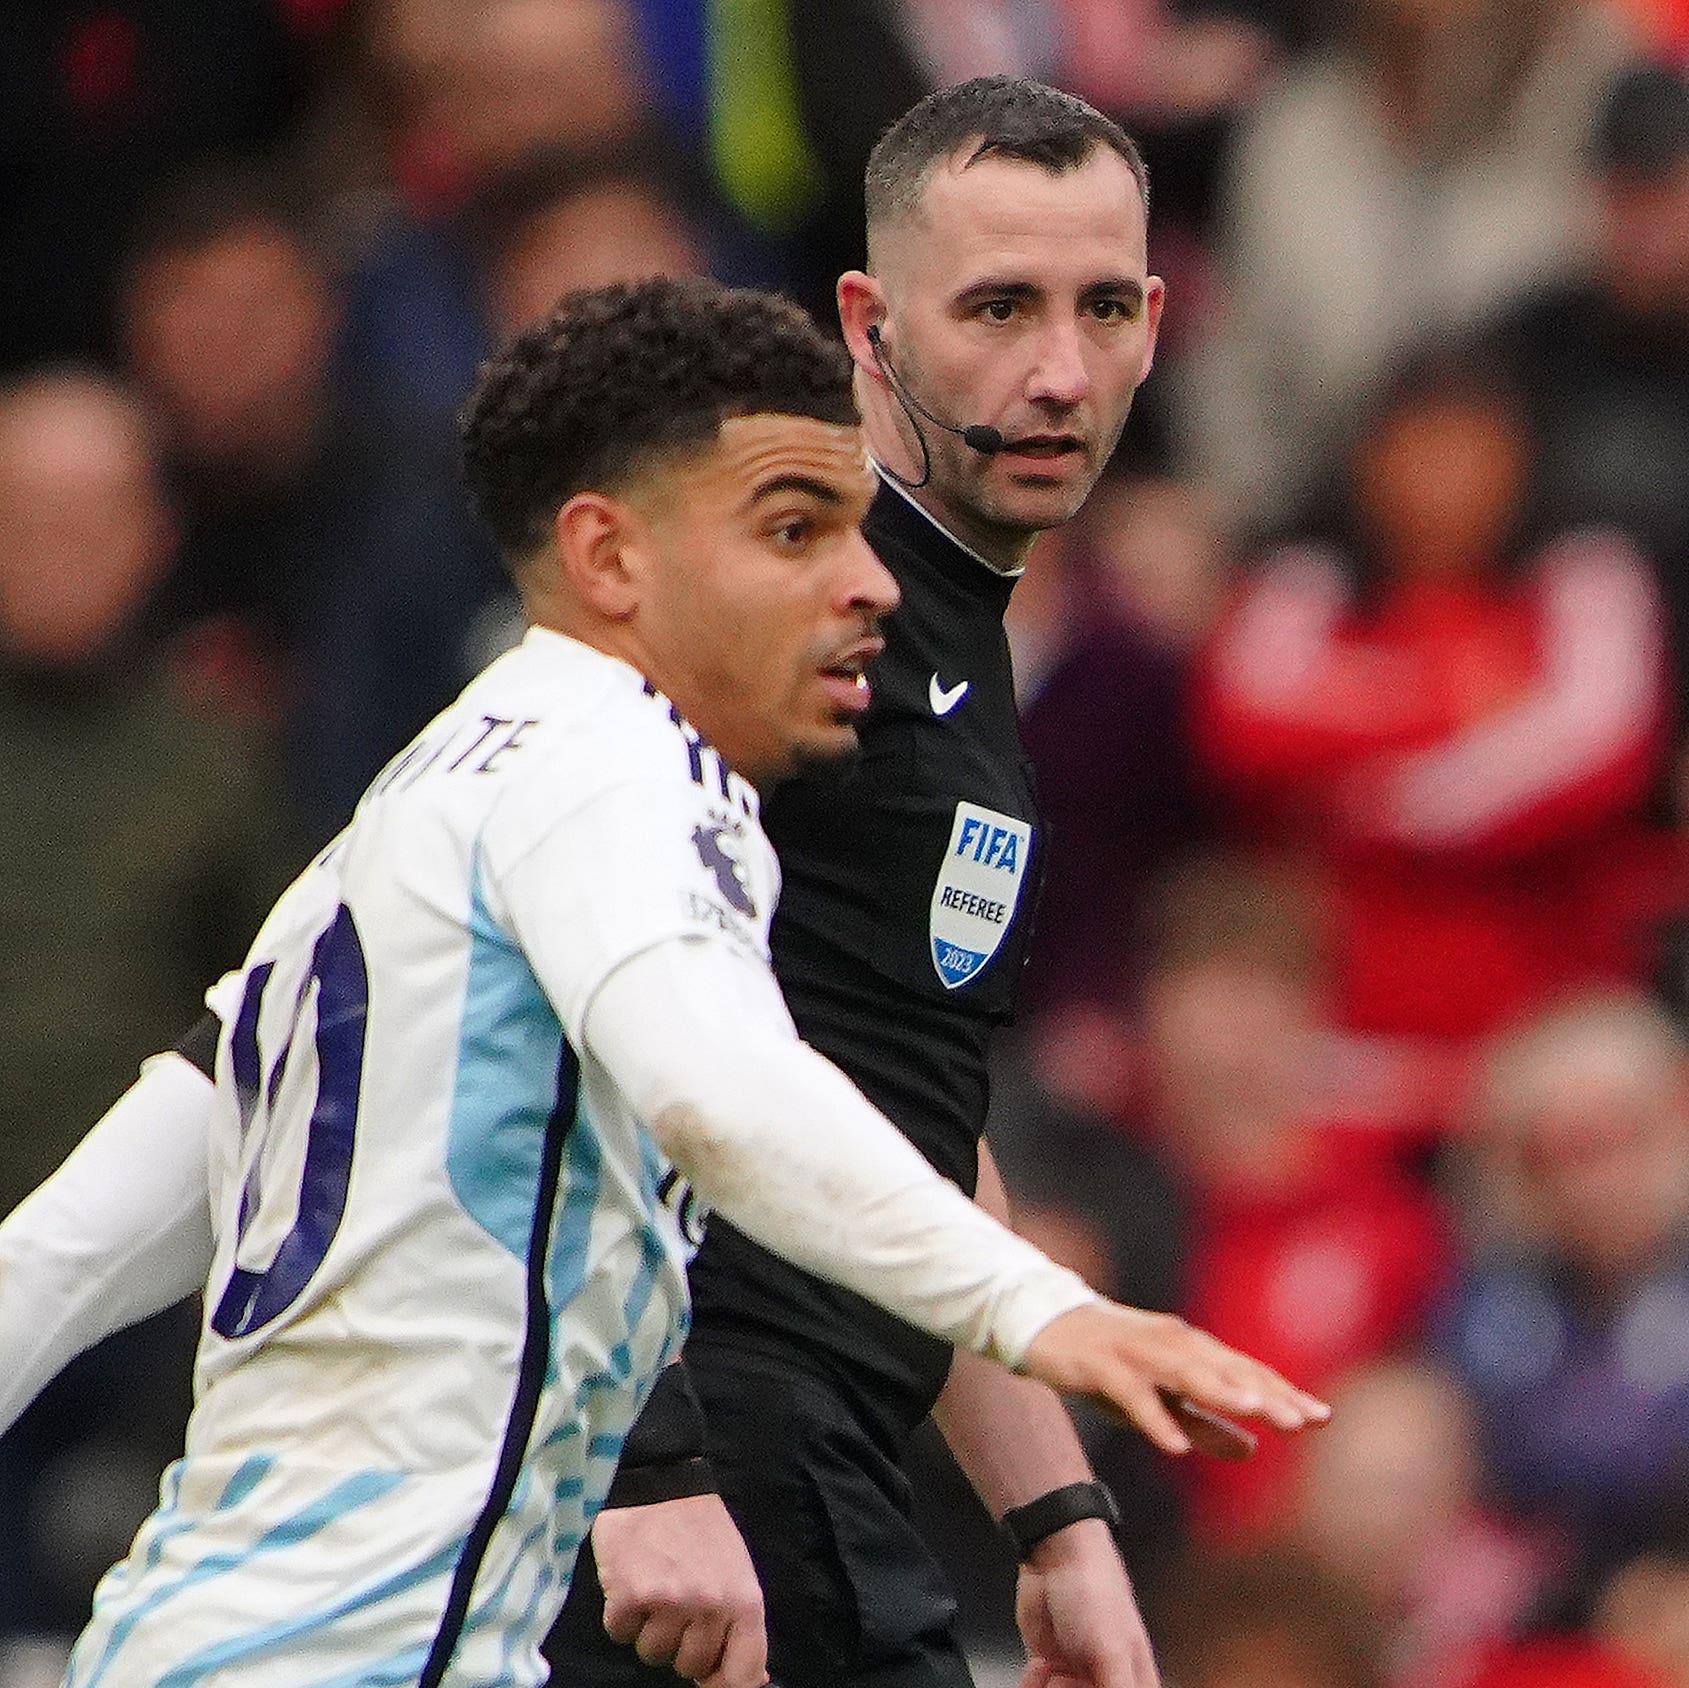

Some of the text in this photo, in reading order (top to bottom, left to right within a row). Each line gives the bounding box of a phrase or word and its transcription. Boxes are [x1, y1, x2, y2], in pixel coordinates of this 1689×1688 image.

[955, 817, 1018, 873] FIFA
[940, 886, 1006, 924] REFEREE
[940, 947, 973, 974] 2023
